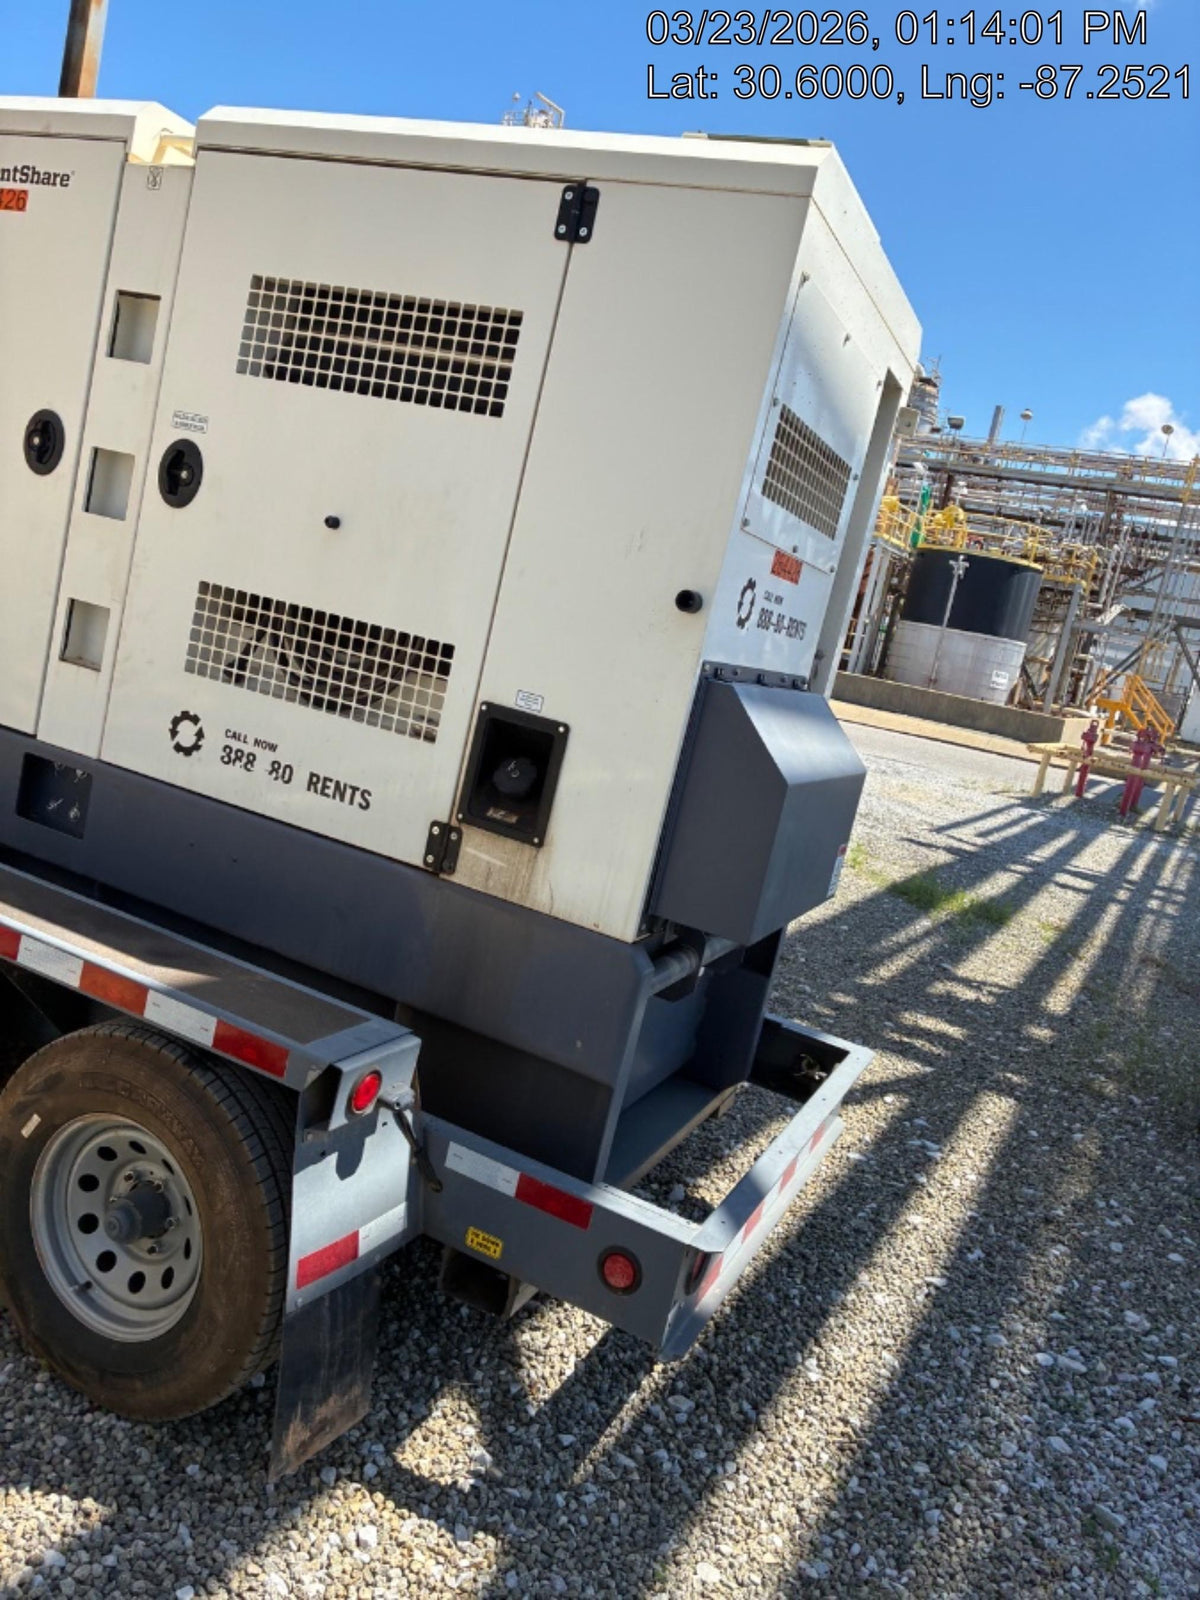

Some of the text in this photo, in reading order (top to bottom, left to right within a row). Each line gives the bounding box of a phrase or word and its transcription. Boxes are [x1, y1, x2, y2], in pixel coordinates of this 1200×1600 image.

[225, 728, 278, 752] CALL NOW
[306, 771, 372, 811] RENTS
